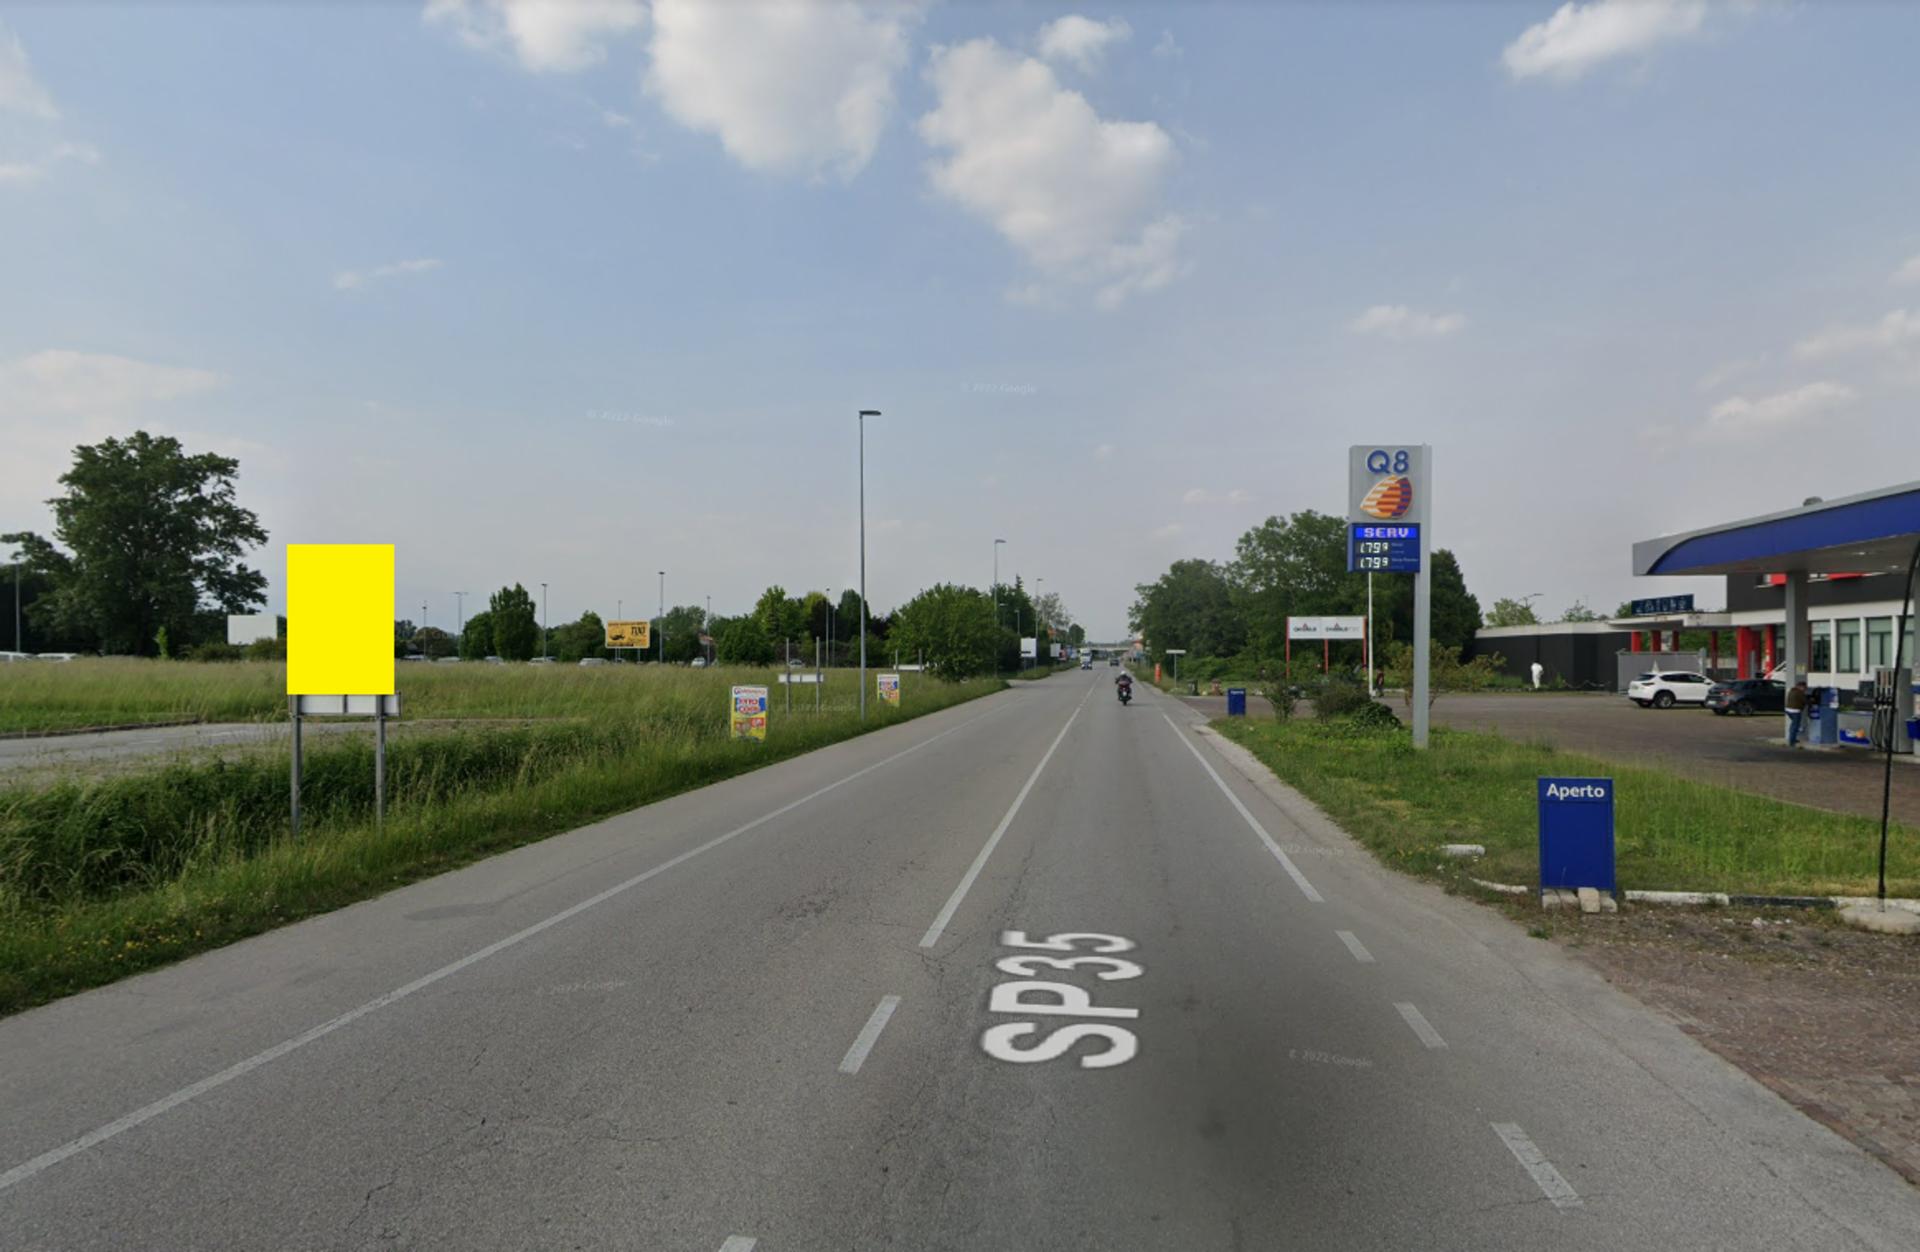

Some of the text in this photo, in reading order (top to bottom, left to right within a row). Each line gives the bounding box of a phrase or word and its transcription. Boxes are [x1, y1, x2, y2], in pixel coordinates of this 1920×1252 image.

[1367, 450, 1409, 474] Q8
[1364, 527, 1409, 538] SERV
[1546, 783, 1605, 801] Aperto
[981, 930, 1145, 1069] SP35
